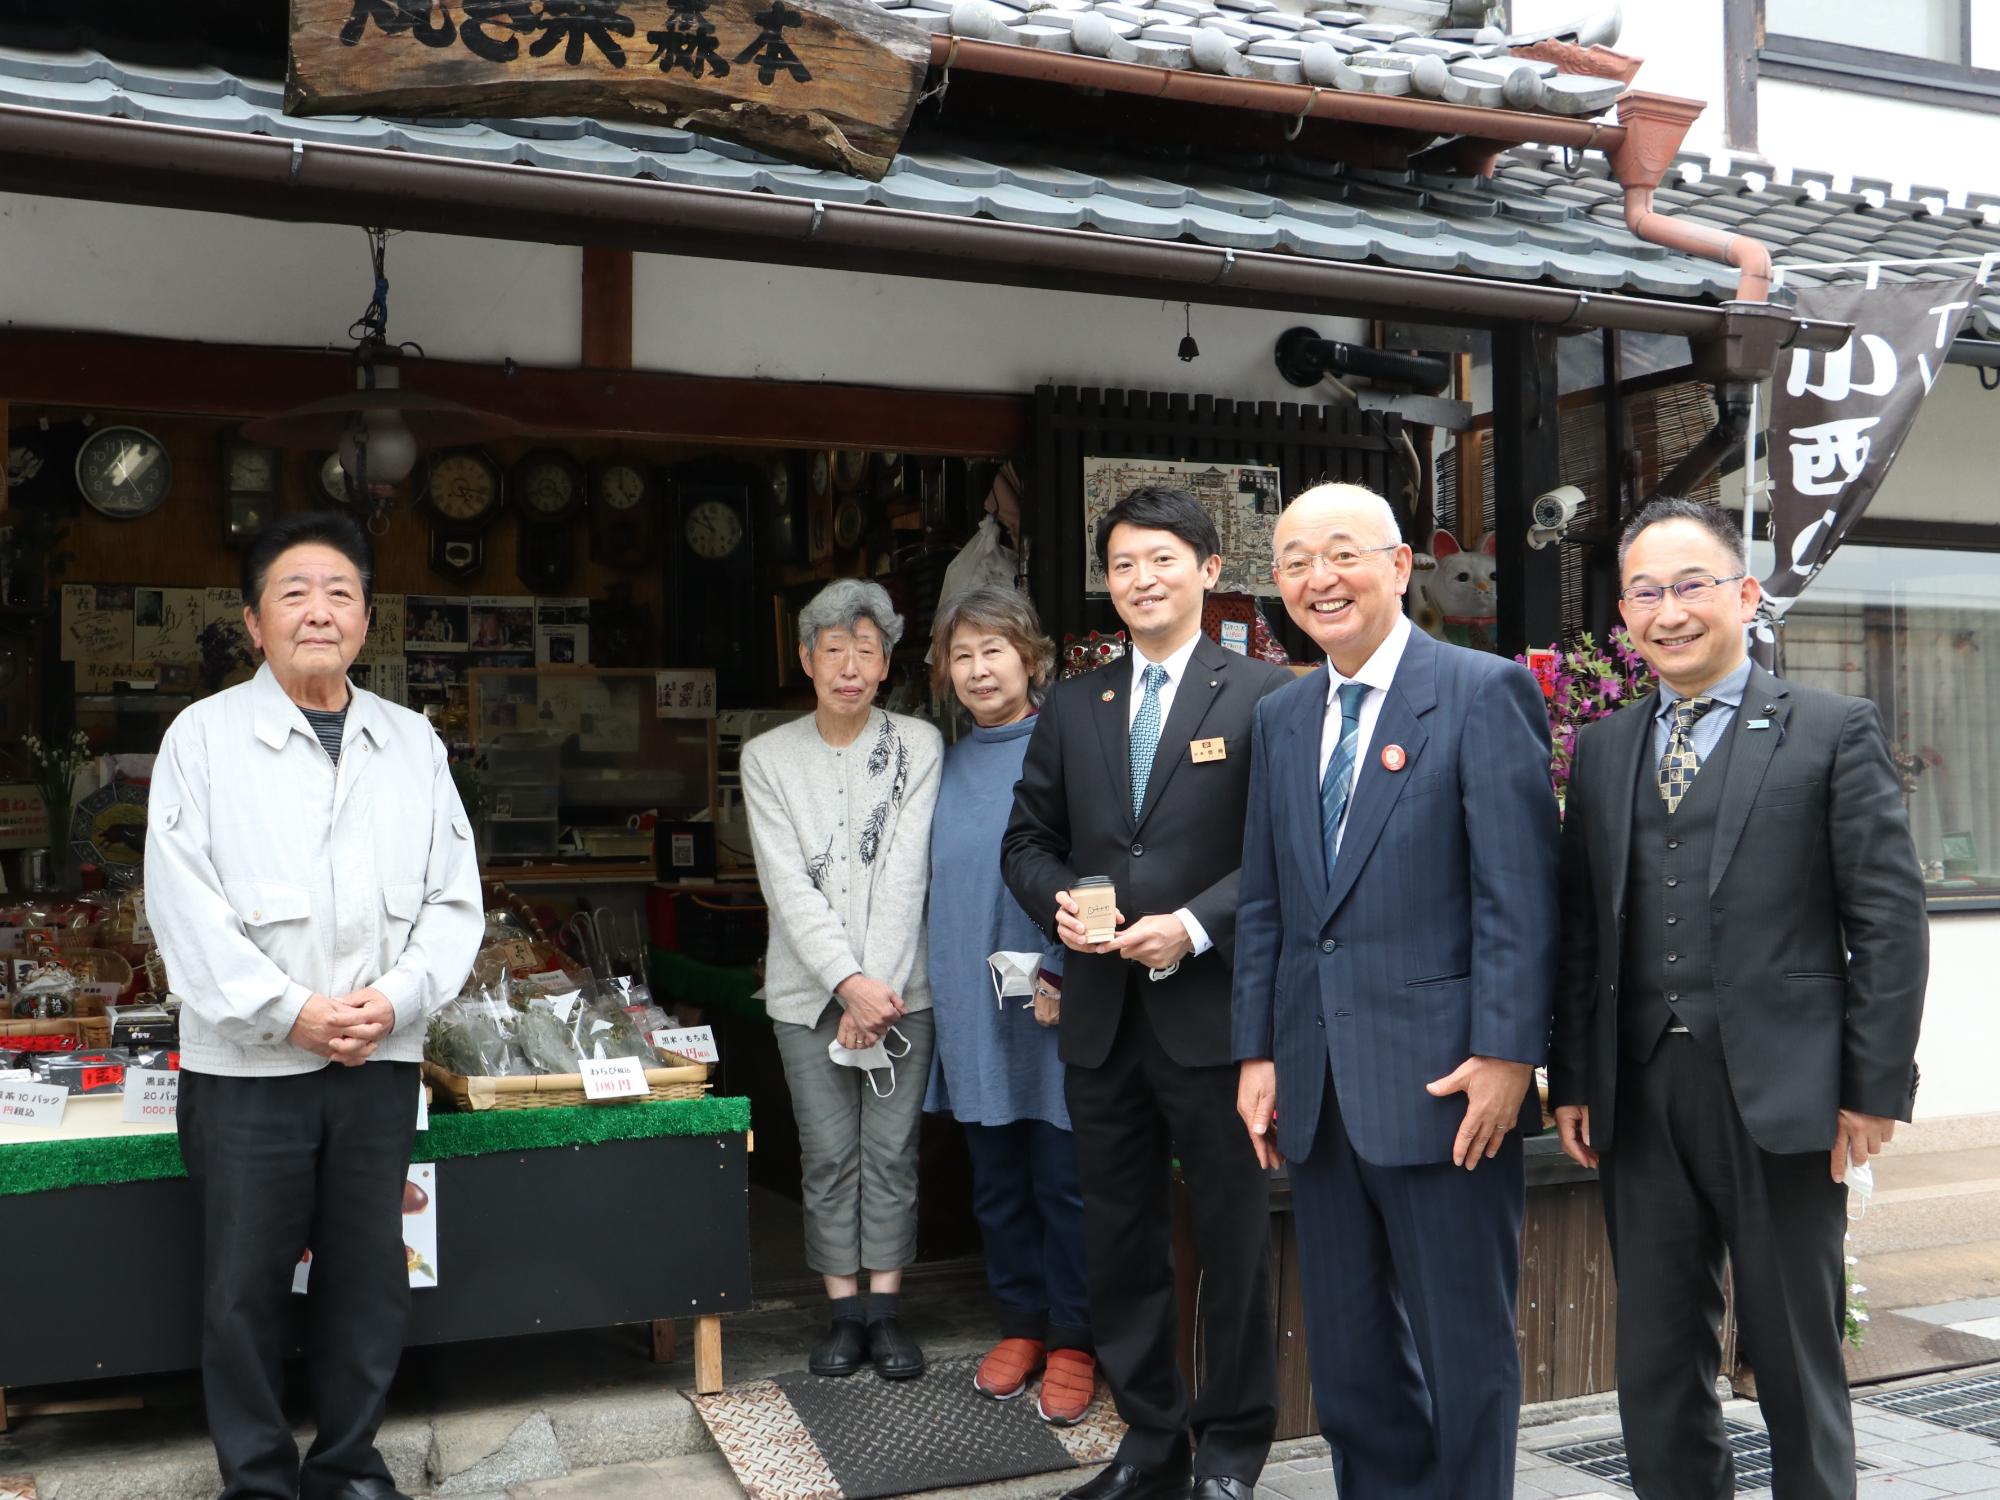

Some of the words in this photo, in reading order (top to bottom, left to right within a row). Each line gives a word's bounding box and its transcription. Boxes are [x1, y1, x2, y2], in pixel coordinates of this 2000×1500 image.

[595, 1080, 616, 1092] 100
[618, 1079, 632, 1091] 円
[32, 1094, 61, 1106] パック
[143, 1091, 158, 1100] 20
[143, 1105, 166, 1115] 1000
